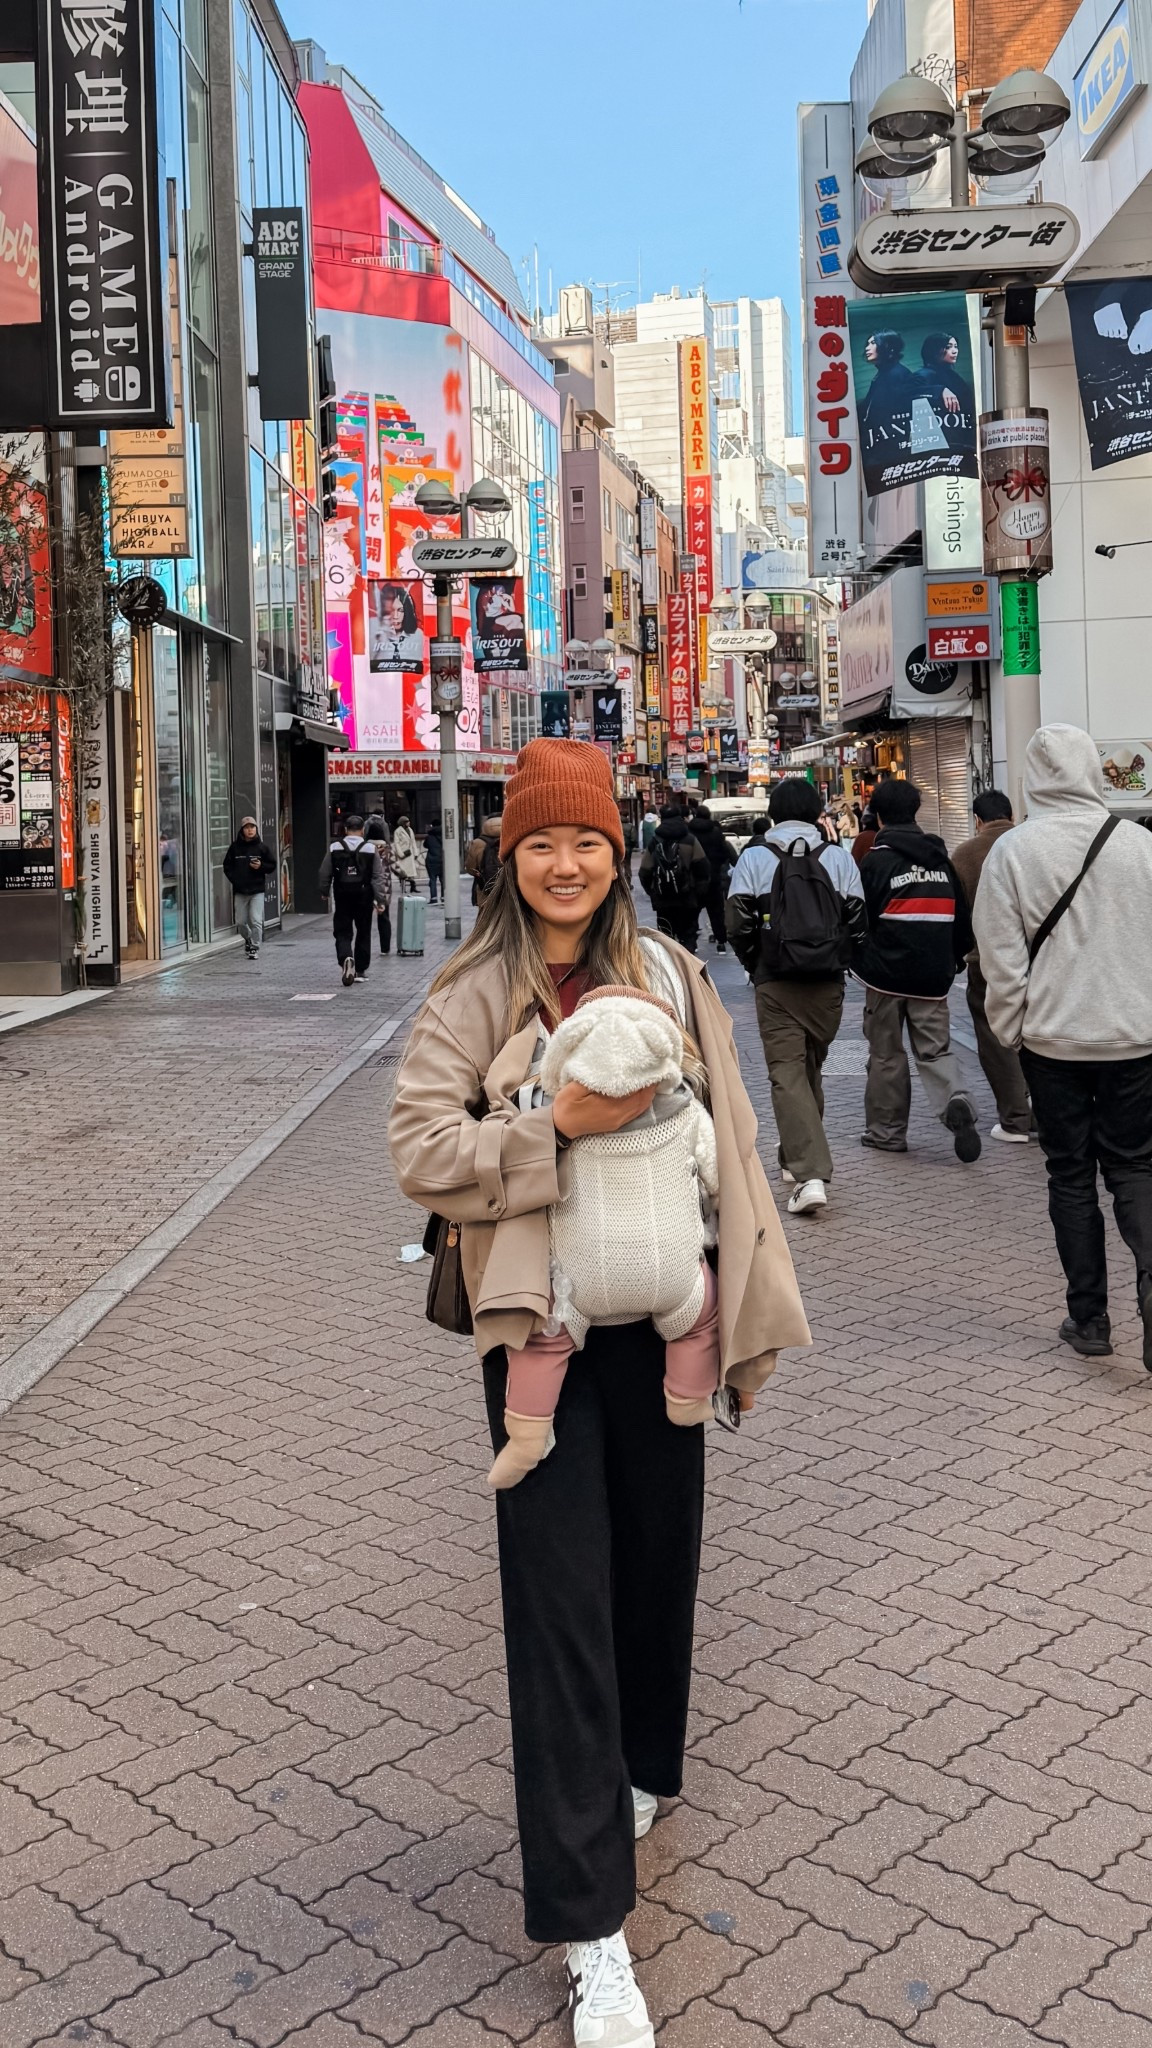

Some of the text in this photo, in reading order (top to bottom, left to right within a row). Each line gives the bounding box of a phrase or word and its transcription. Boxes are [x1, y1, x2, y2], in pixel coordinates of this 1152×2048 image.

[1080, 36, 1127, 126] IKEA
[258, 221, 299, 241] ABC
[870, 220, 1067, 255] 渋谷センター街
[258, 242, 299, 256] MART
[96, 173, 139, 356] GAME
[259, 262, 295, 270] GRAND
[64, 176, 101, 372] Android
[259, 270, 292, 278] STAGE
[866, 413, 972, 449] JANE DOE
[987, 432, 1046, 445] drink at public places
[881, 454, 964, 481] 渋谷センター街
[121, 514, 171, 523] SHIBUYA
[1008, 508, 1040, 526] Happy
[122, 528, 180, 536] HIGHBALL
[1016, 521, 1046, 536] Winter
[122, 541, 145, 549] BAR
[825, 538, 846, 549] 渋谷
[417, 546, 508, 560] 渋谷センター街
[670, 595, 688, 665] カラオケ
[475, 638, 523, 650] IRIS OUT
[712, 635, 772, 645] 渋谷センター街
[672, 685, 690, 737] 歌広場
[328, 759, 372, 775] SMASH
[91, 833, 101, 941] SHIBUYA HIGHBALL
